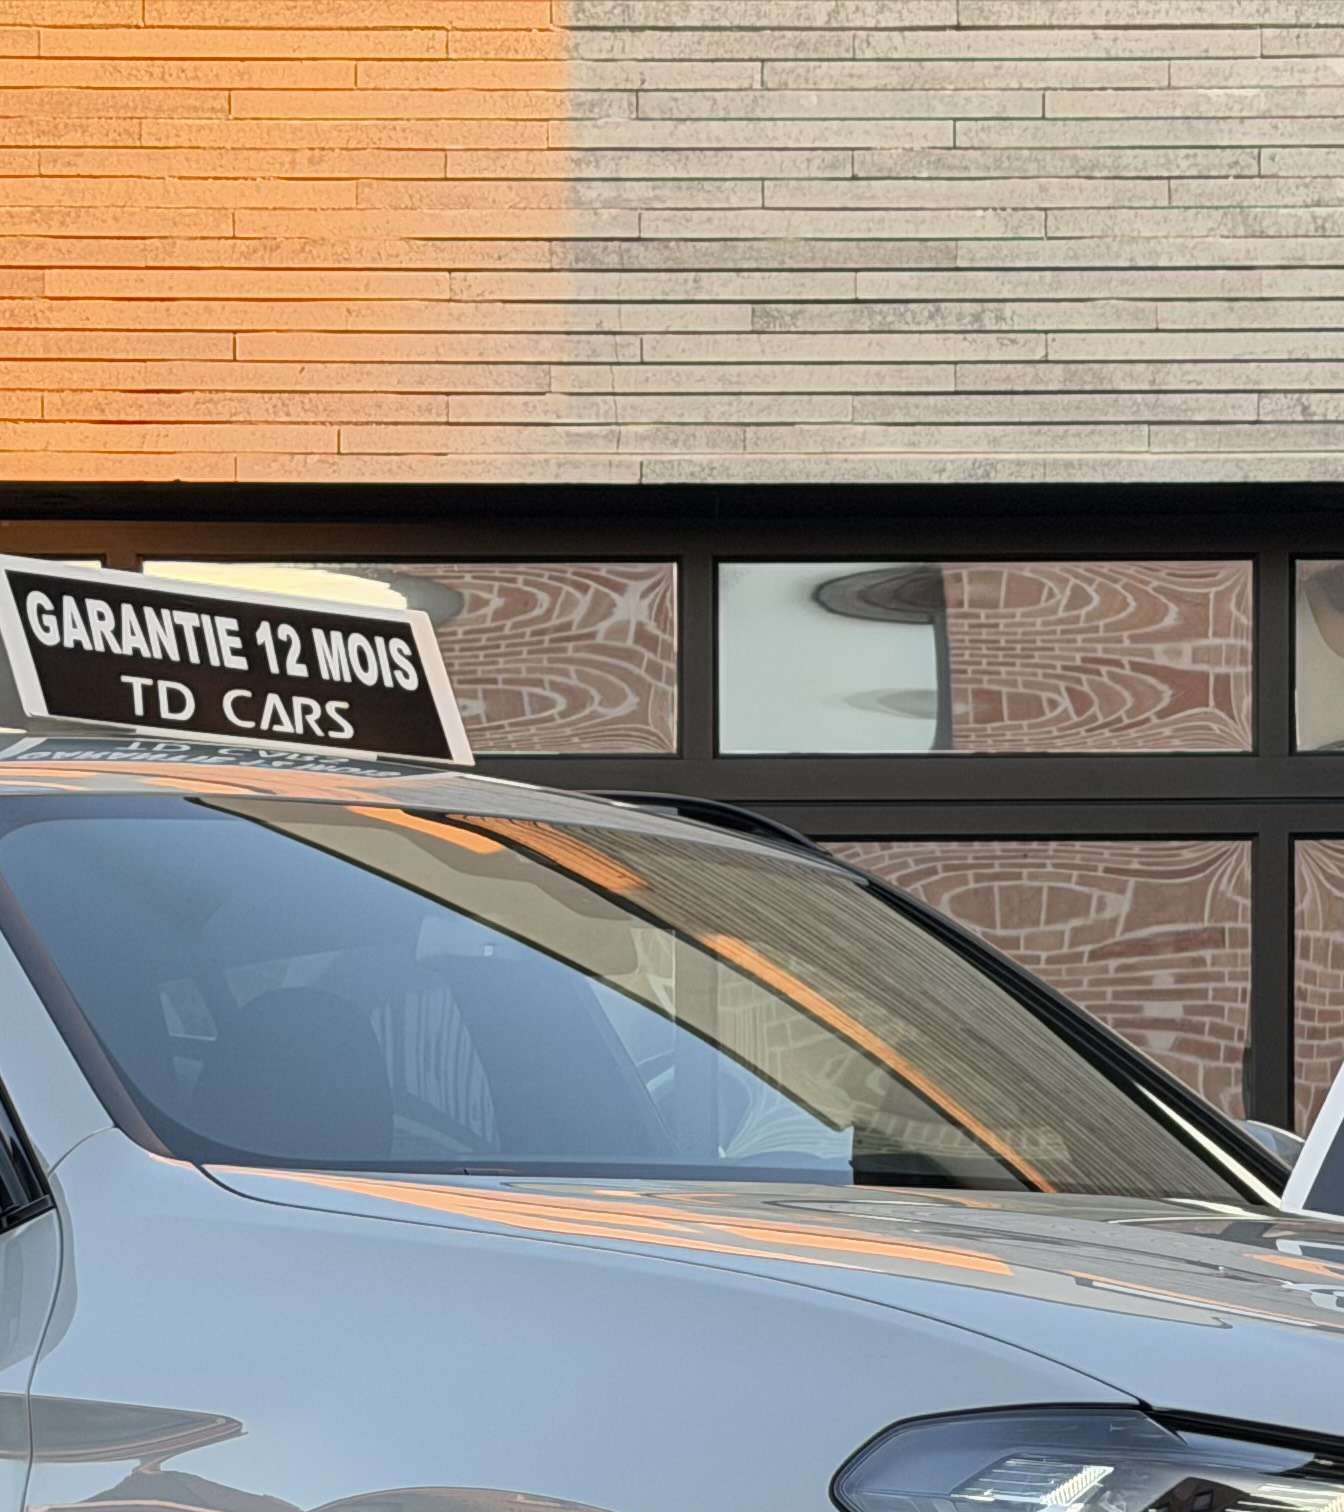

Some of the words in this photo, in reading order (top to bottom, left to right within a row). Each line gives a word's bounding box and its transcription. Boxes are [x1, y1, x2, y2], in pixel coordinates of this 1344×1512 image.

[26, 590, 249, 671] GARANTIE
[255, 620, 309, 678] 12
[311, 627, 419, 691] MOIS
[120, 675, 196, 721] TD
[222, 689, 354, 739] CARS
